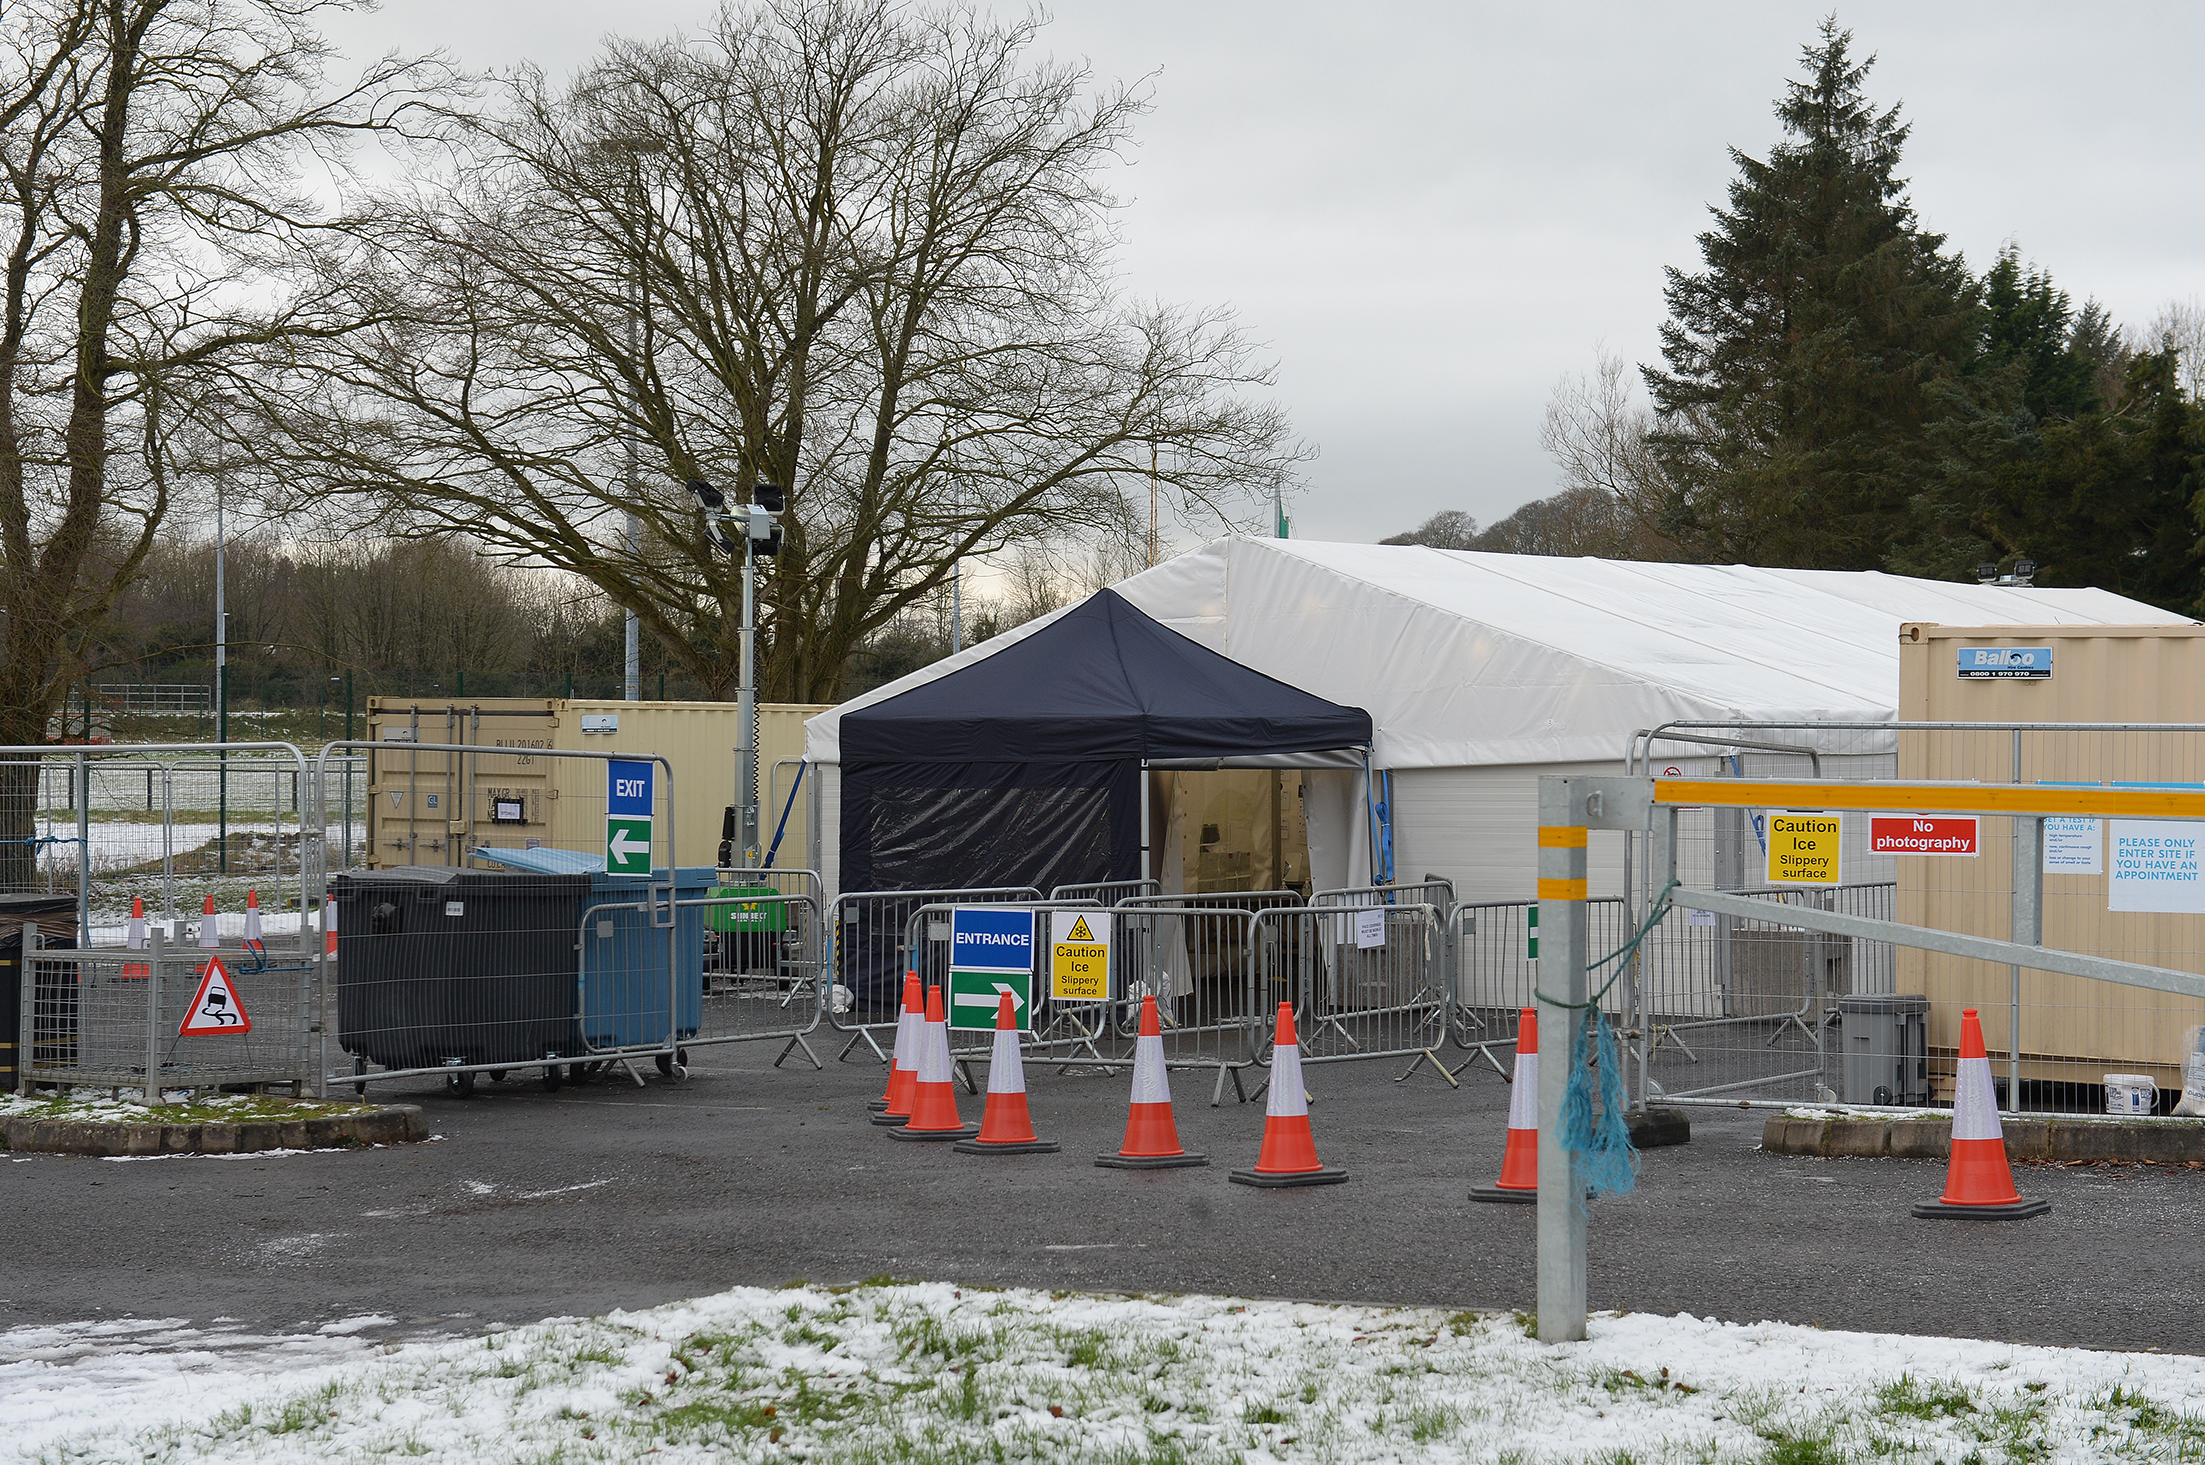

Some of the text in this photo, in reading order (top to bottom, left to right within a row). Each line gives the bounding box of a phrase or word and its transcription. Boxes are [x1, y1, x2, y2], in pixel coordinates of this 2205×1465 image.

[1974, 649, 2035, 666] Balloo
[616, 778, 646, 798] EXIT
[1773, 818, 1837, 833] Caution
[1913, 819, 1934, 833] No
[1792, 836, 1817, 851] Ice
[1876, 835, 1971, 852] photography
[2119, 837, 2196, 848] PLEASE ONLY
[2118, 848, 2196, 859] ENTER SITE IF
[1779, 854, 1830, 868] Slippery
[2116, 859, 2198, 870] YOU HAVE AN
[1782, 867, 1827, 879] surface
[2115, 870, 2199, 881] APPOINTMENT
[955, 932, 1030, 947] ENTRANCE
[1056, 945, 1106, 958] Caution
[1071, 961, 1089, 972] Ice
[1061, 975, 1100, 986] Slippery
[1062, 986, 1098, 995] surface
